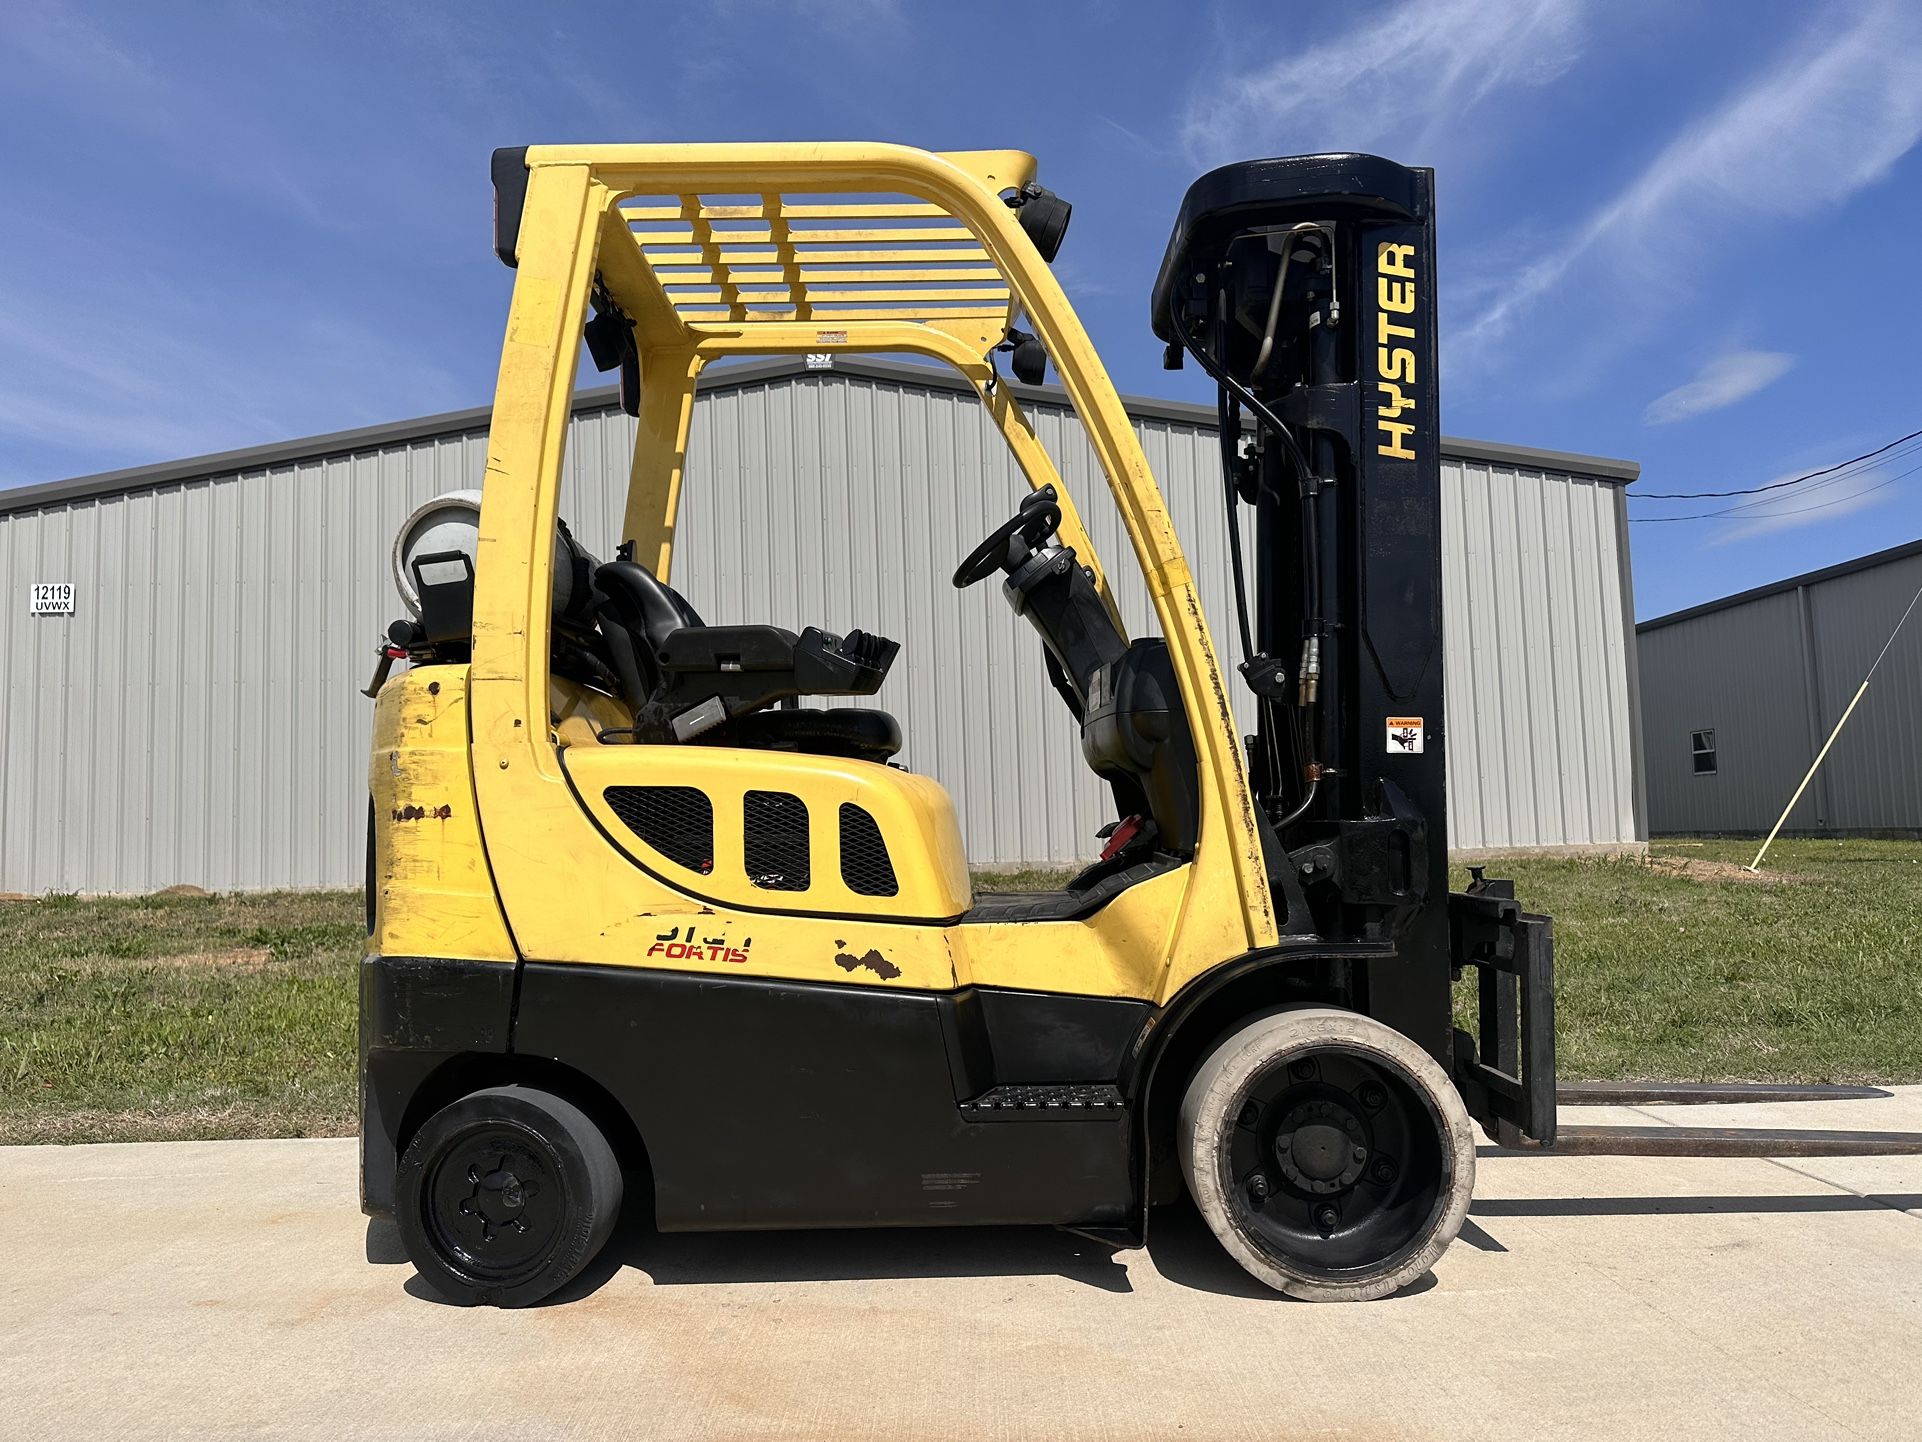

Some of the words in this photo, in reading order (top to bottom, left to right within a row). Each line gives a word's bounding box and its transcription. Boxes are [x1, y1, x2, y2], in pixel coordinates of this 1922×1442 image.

[1378, 241, 1416, 461] HYSTER
[34, 584, 71, 600] 12119
[35, 601, 70, 611] UVWX
[647, 942, 749, 963] FORTIS
